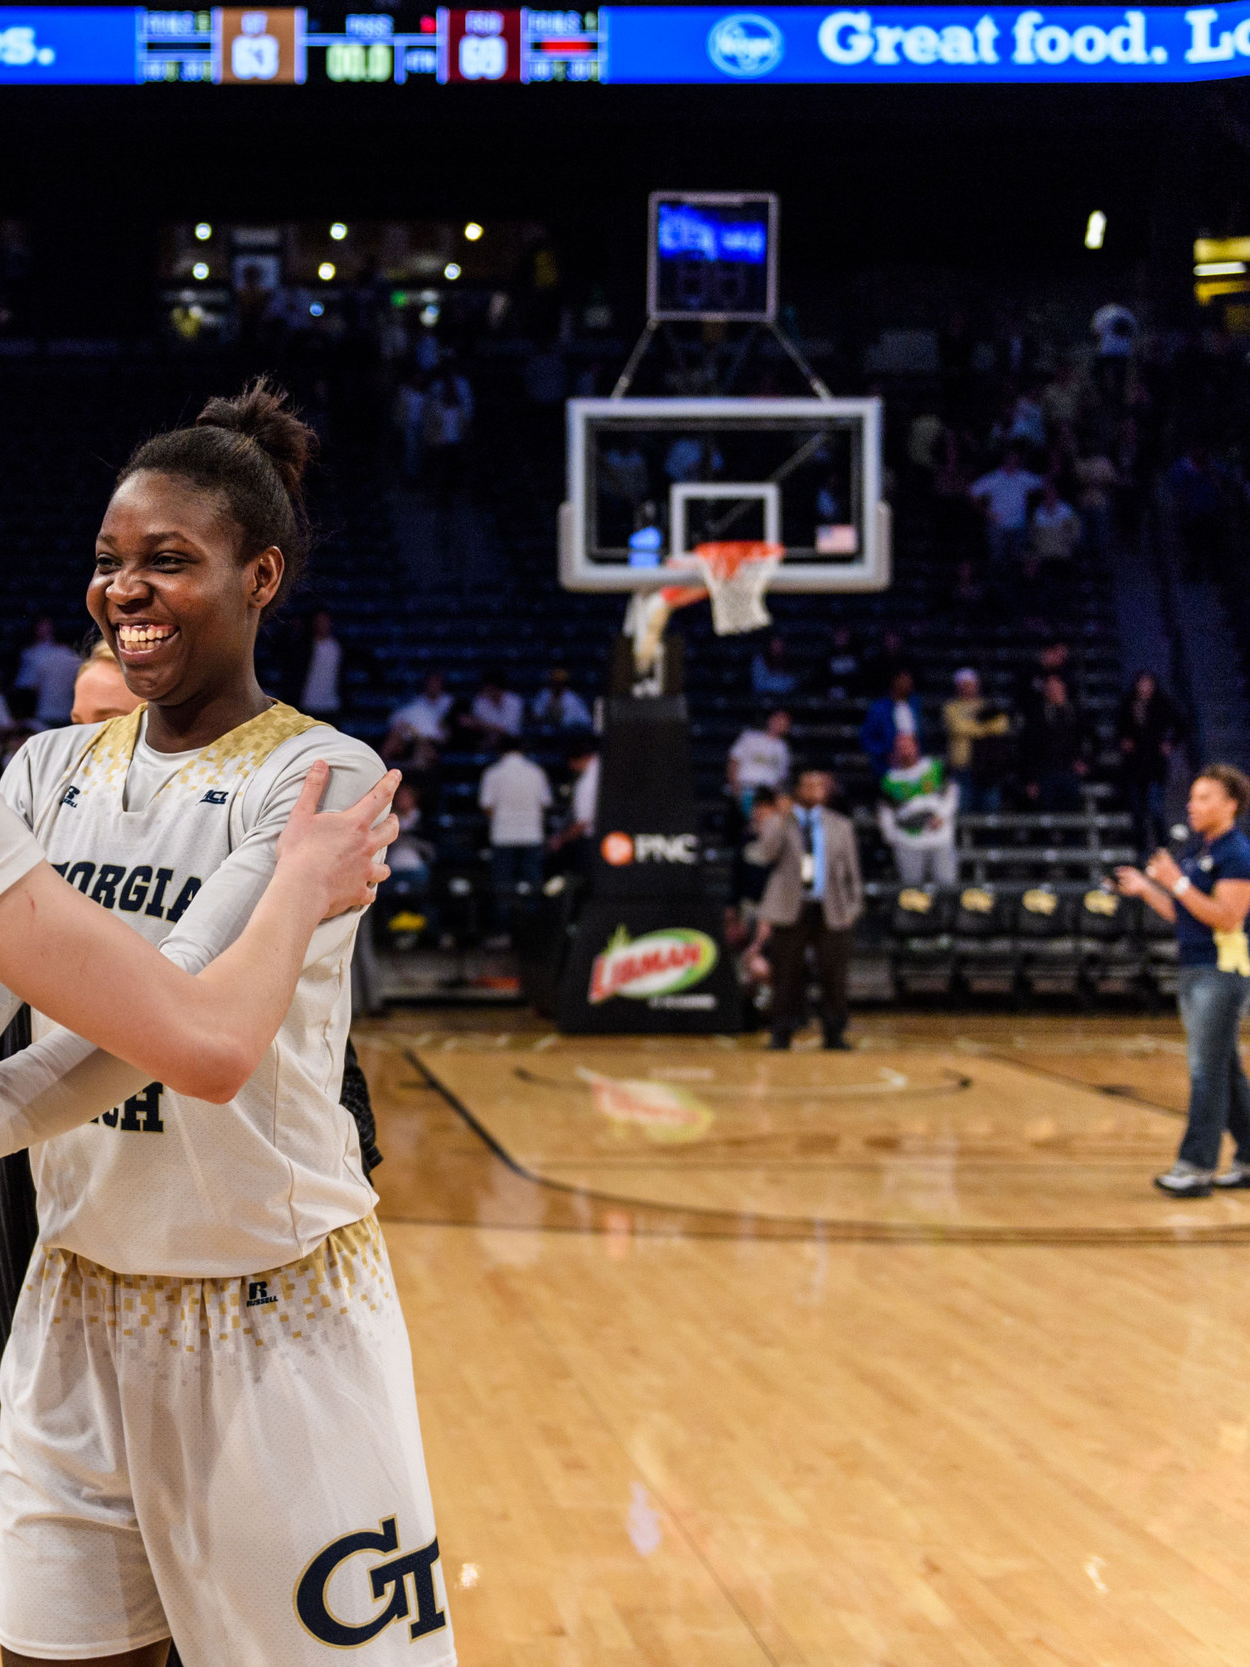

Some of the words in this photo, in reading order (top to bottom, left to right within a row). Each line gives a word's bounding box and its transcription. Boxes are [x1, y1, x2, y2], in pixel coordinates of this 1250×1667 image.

[817, 10, 1000, 65] Great
[1012, 10, 1169, 65] food.
[634, 832, 699, 865] PNC
[50, 860, 203, 924] ORGIA
[246, 1295, 279, 1308] RUSSELL
